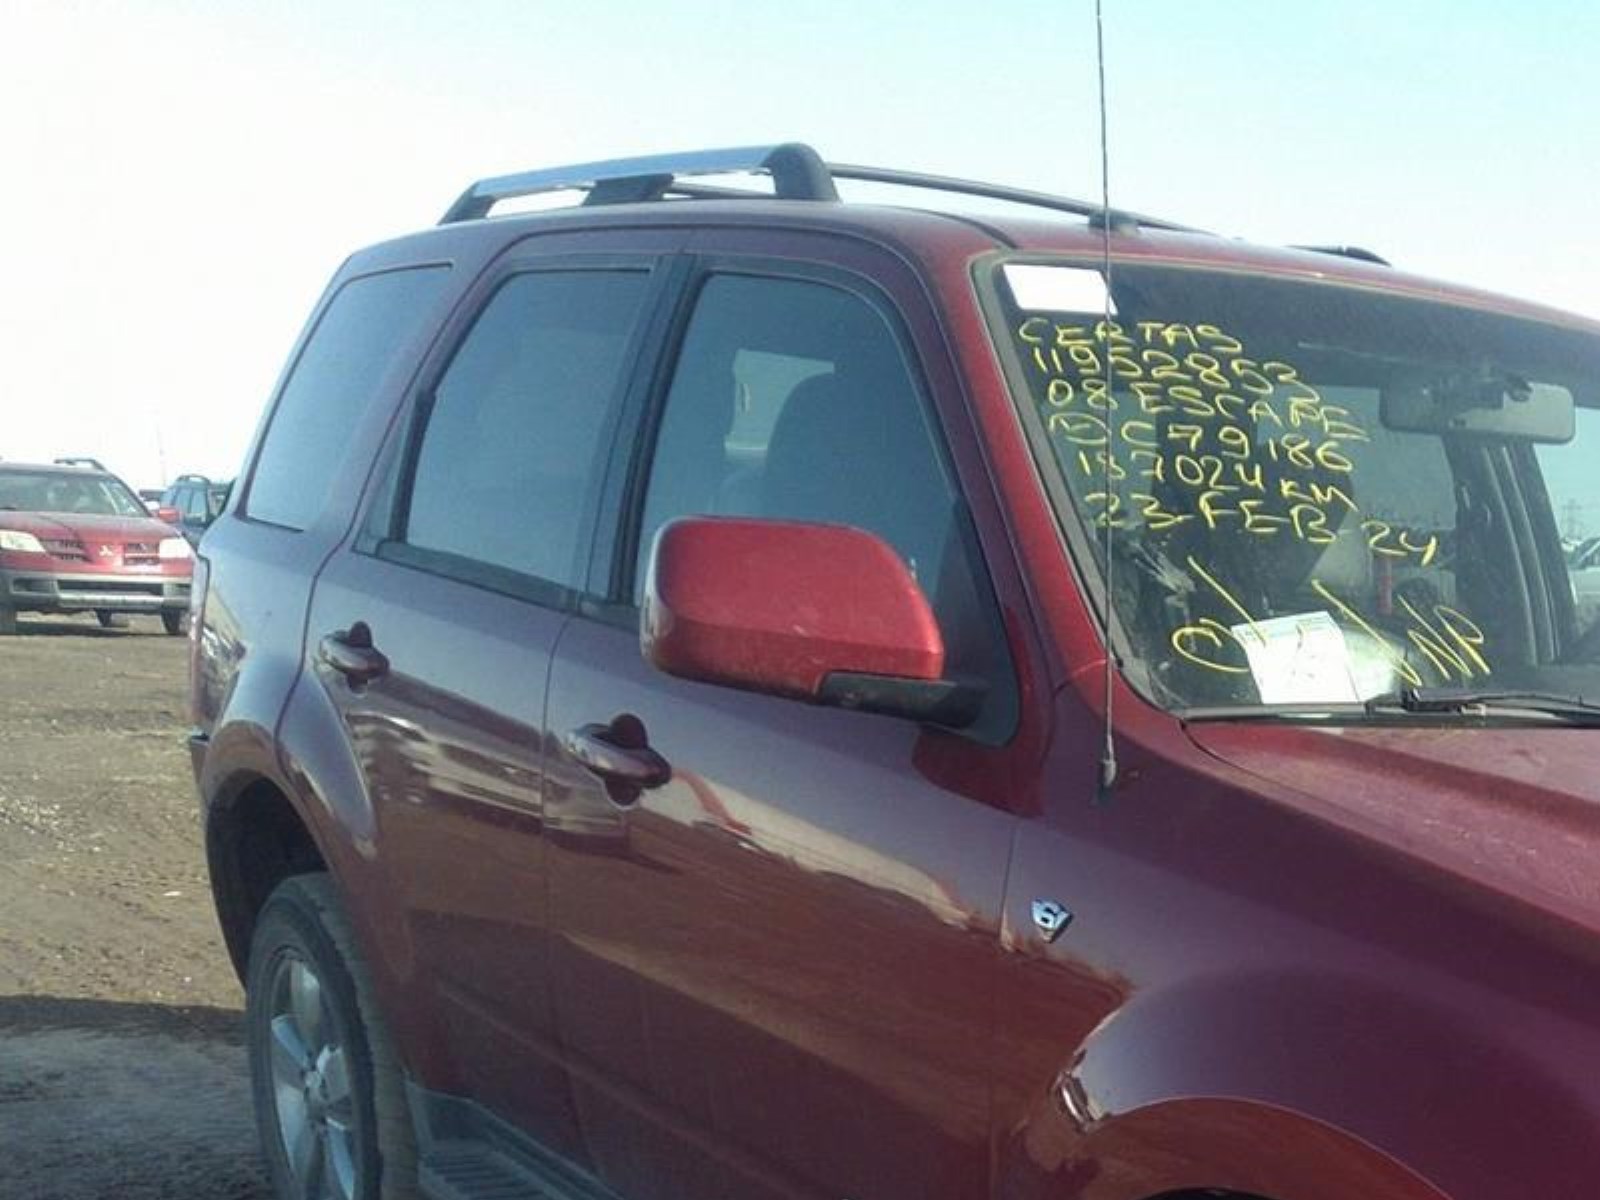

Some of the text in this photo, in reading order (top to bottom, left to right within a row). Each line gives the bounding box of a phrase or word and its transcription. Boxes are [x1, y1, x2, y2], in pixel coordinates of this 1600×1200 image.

[1018, 317, 1243, 352] CERTAS
[1033, 344, 1321, 404] 11952853
[1048, 378, 1371, 443] 08 ESCAPE
[1278, 477, 1360, 512] KM
